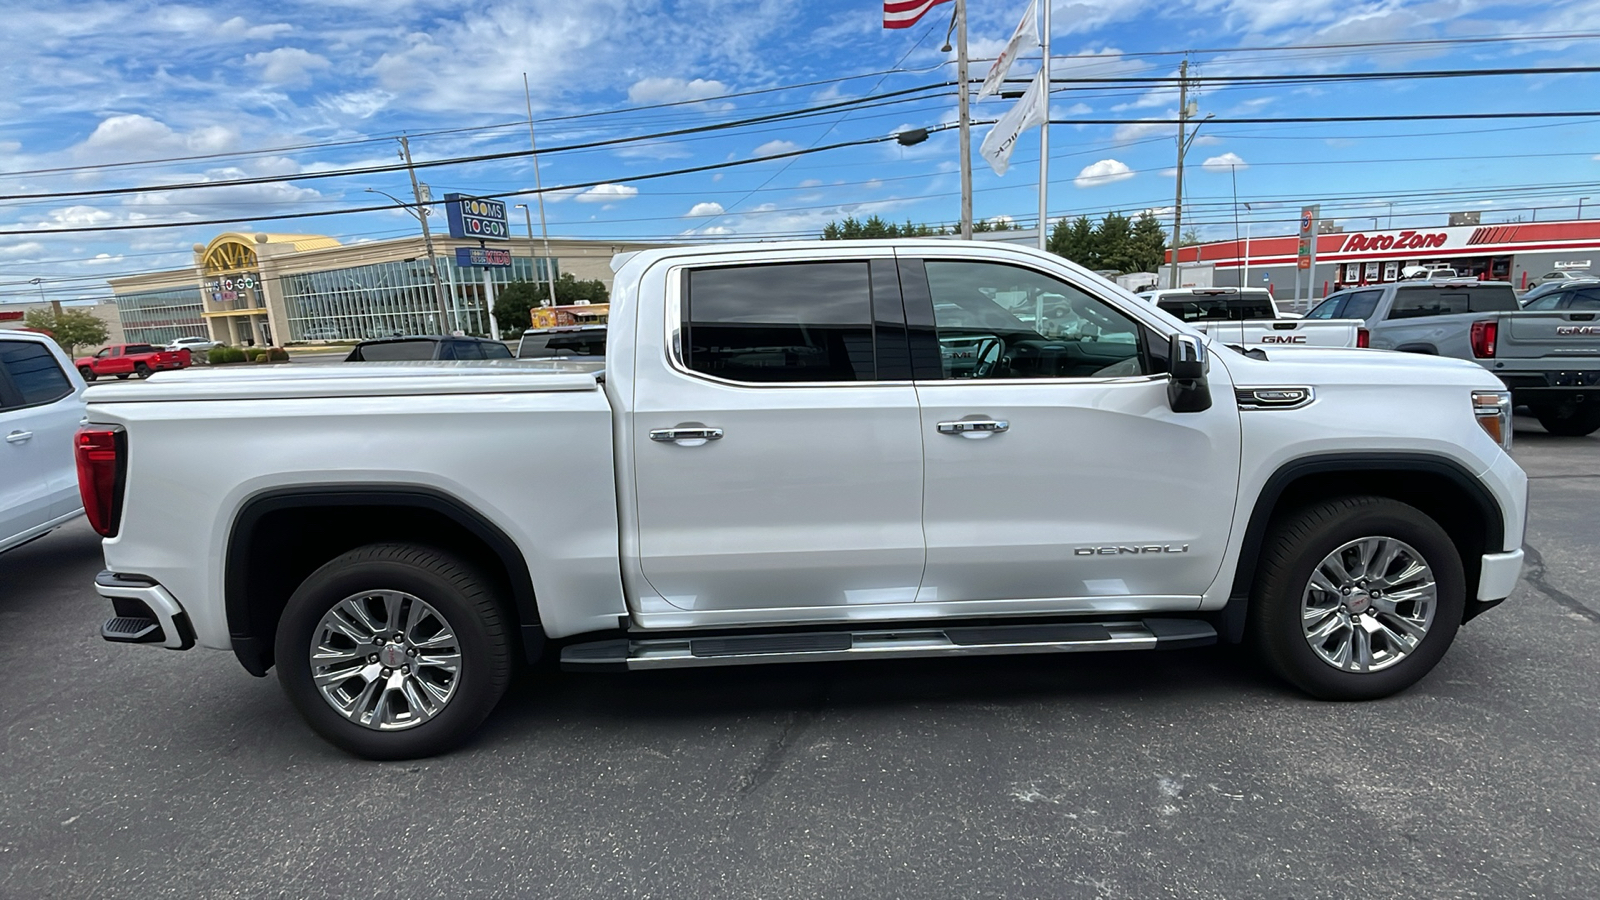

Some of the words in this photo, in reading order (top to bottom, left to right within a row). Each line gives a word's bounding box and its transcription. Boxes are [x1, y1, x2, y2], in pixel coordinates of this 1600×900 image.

[464, 200, 502, 218] ROOMS
[466, 218, 480, 233] TO
[482, 220, 500, 235] GO
[1342, 230, 1447, 252] AutoZone
[486, 250, 511, 265] KIDS
[236, 278, 254, 289] GO
[1556, 325, 1600, 335] GMC
[1262, 335, 1307, 344] GMC
[1074, 543, 1189, 556] DENALI
